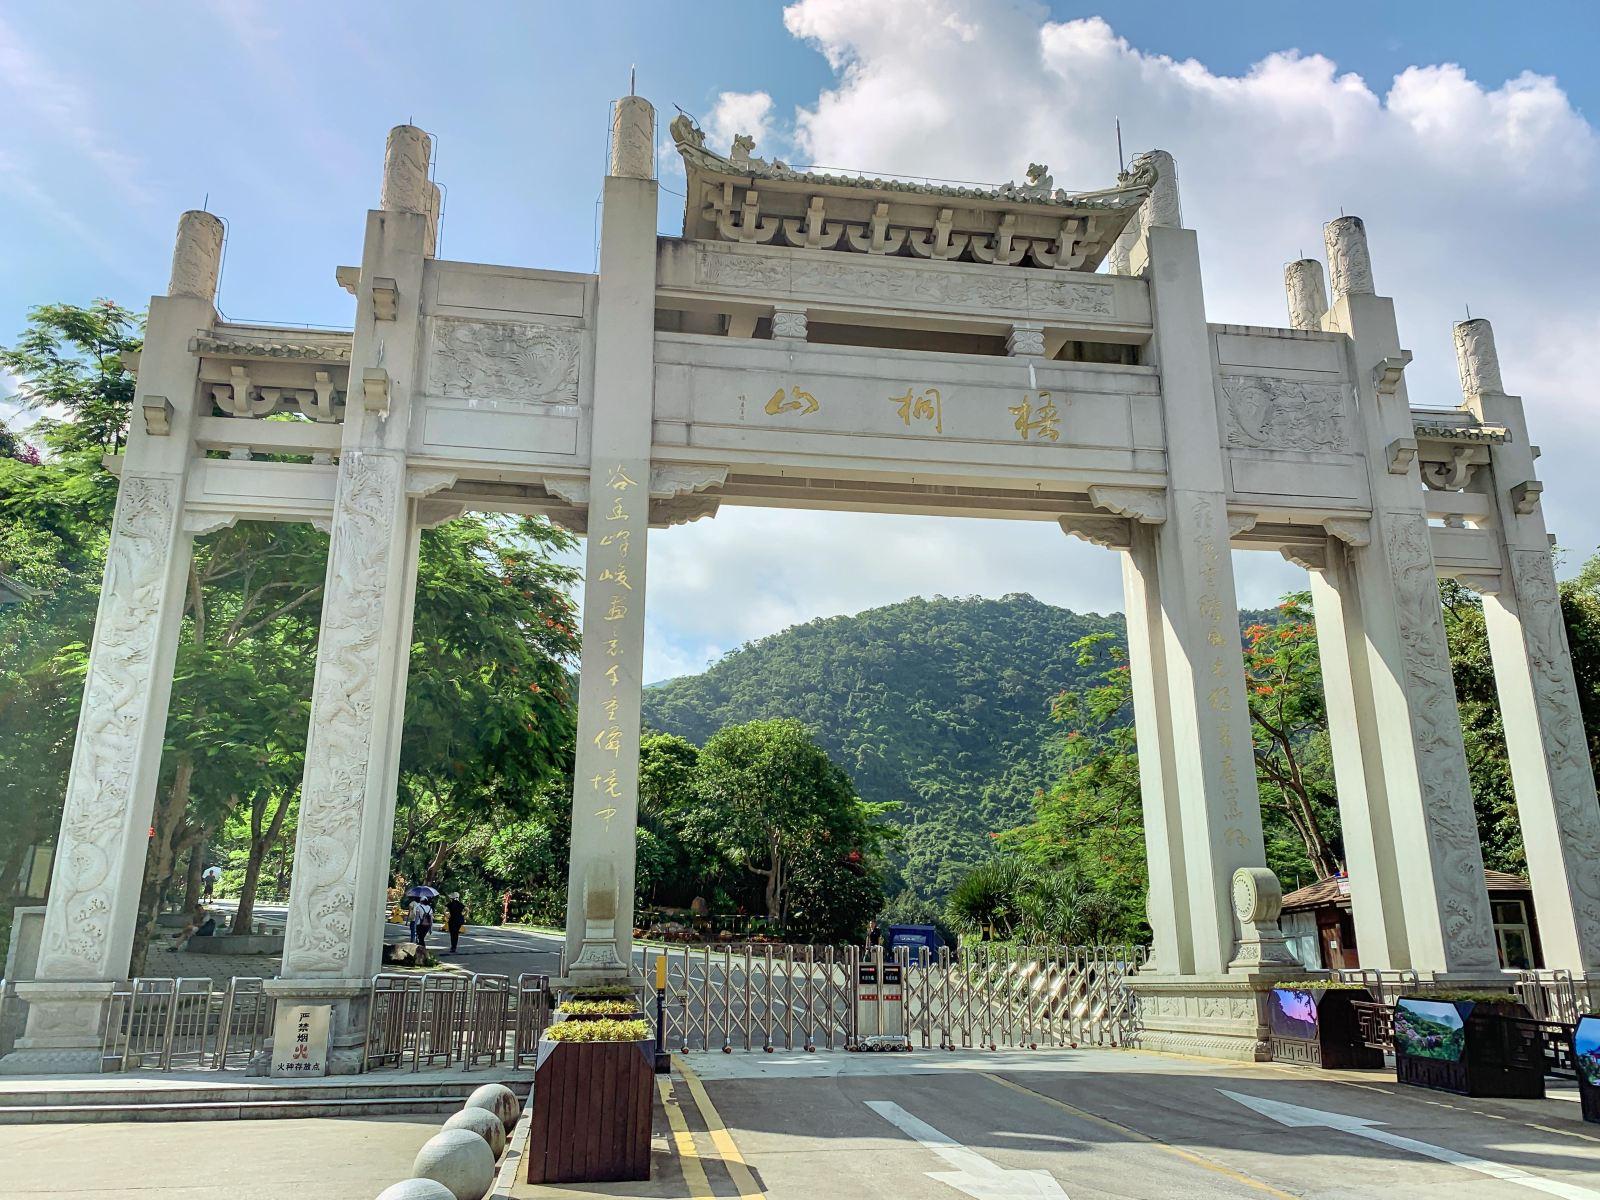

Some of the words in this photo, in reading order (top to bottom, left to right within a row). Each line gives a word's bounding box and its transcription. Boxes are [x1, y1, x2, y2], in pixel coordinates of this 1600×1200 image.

[292, 1012, 311, 1060] 严禁烟火
[277, 1062, 321, 1072] 火种存放点
